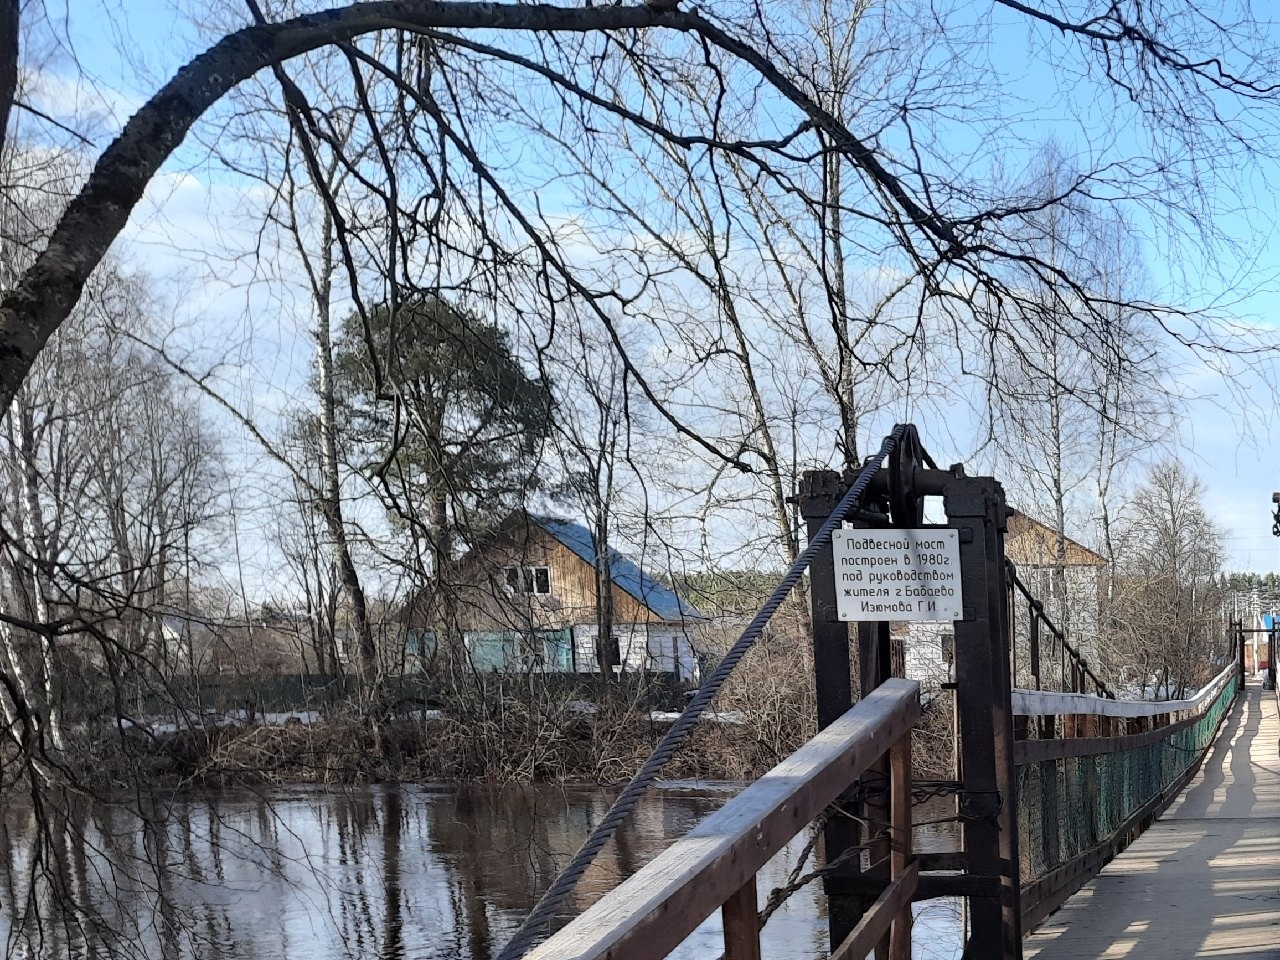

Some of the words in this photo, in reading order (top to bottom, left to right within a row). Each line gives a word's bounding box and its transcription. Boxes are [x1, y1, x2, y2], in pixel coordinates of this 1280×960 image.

[846, 538, 910, 550] Подвесной
[915, 540, 945, 550] мост
[841, 556, 898, 568] построен
[903, 554, 911, 565] в
[842, 570, 863, 581] под
[869, 569, 954, 585] руководством
[843, 588, 890, 597] жителя
[861, 601, 913, 613] Изюмова
